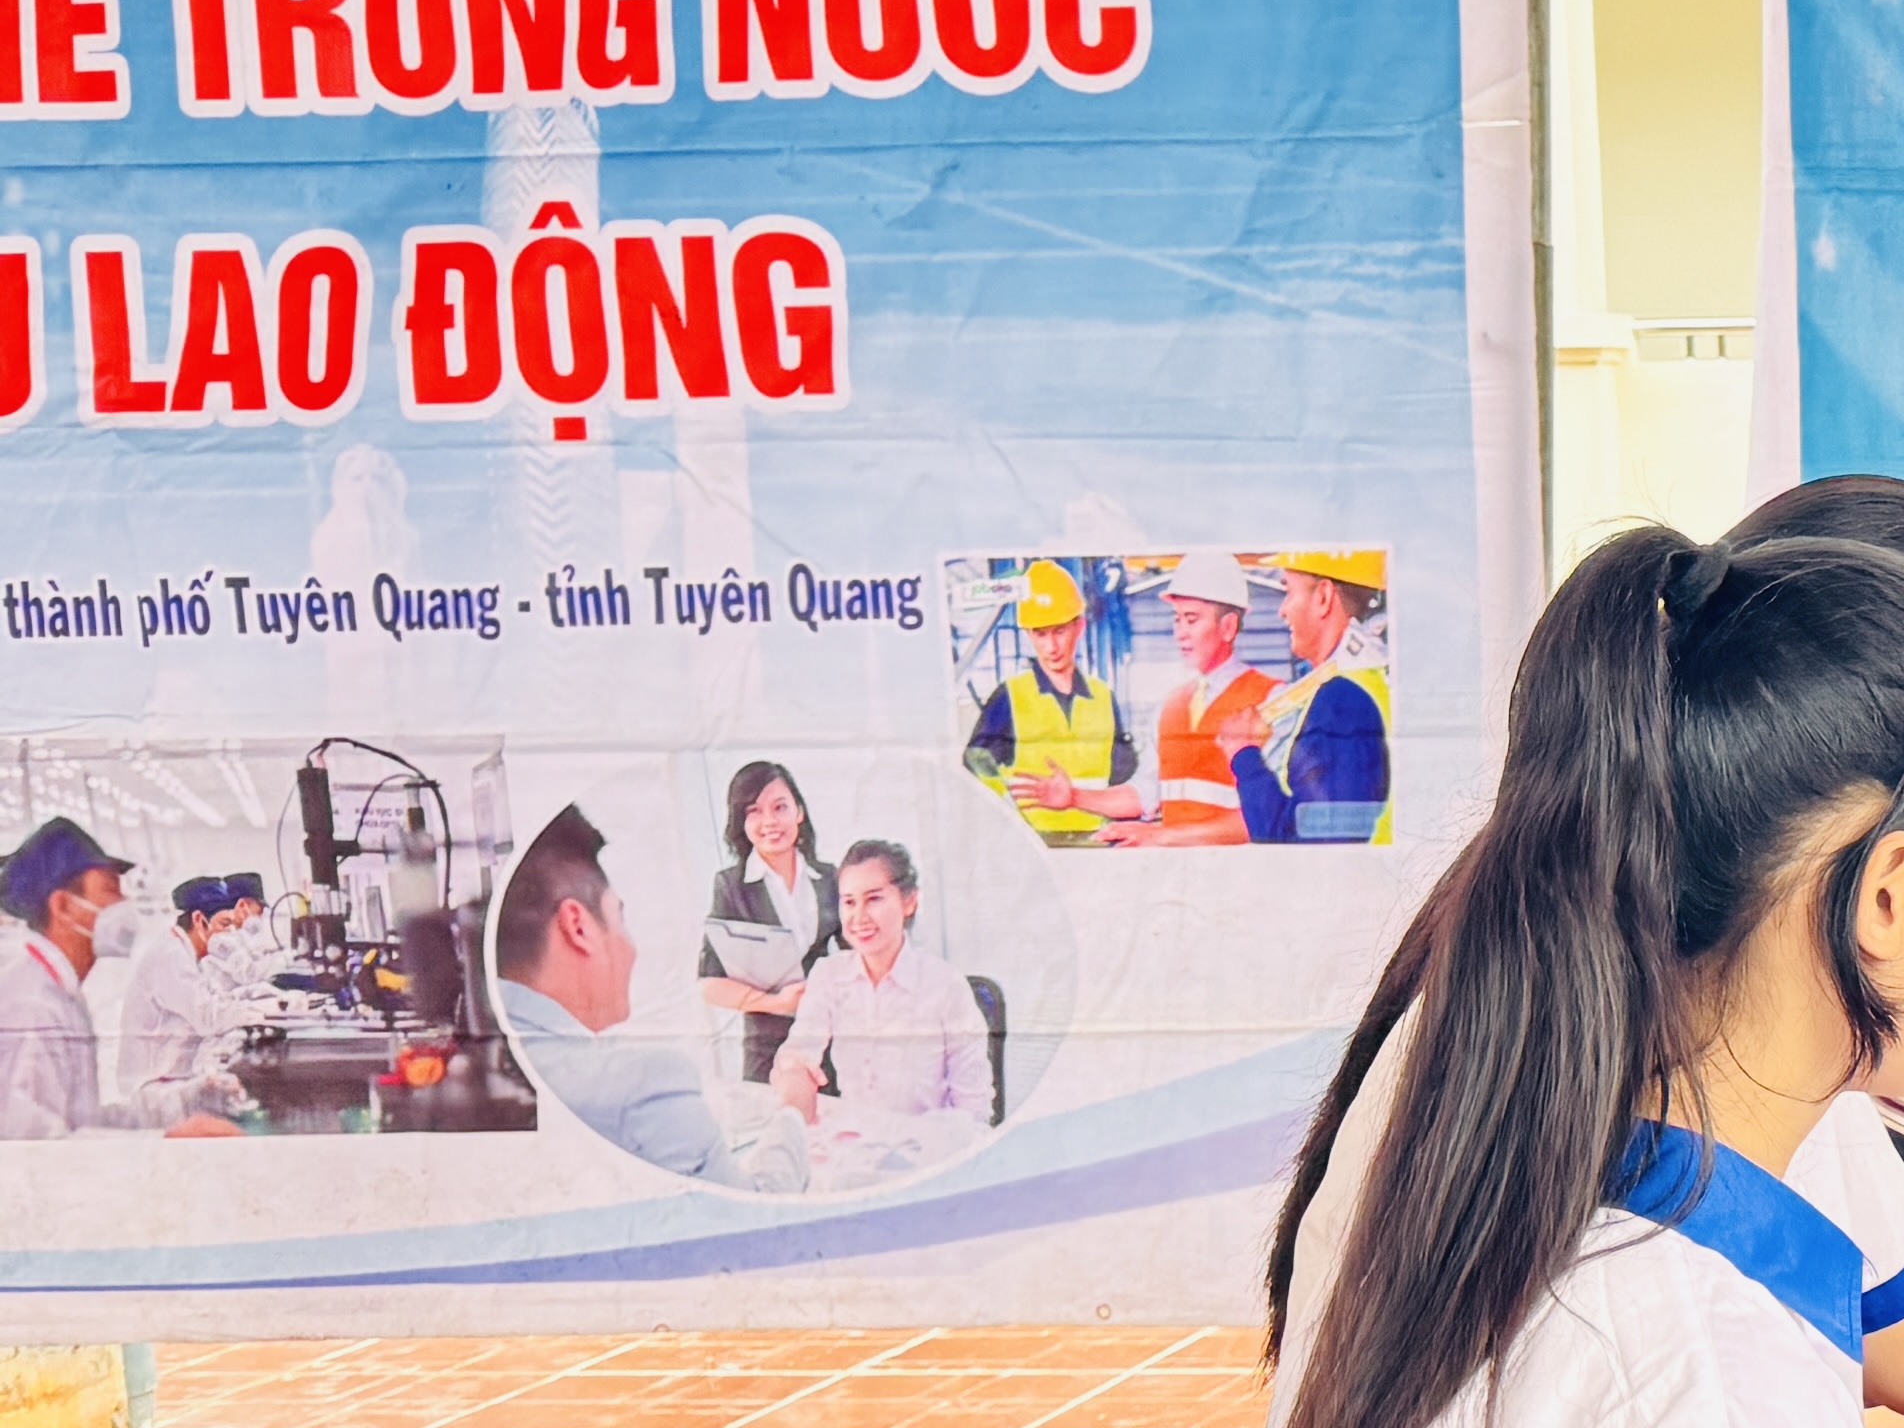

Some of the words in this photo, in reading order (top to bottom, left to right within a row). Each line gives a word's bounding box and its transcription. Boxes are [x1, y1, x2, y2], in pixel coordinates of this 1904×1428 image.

[87, 247, 357, 412] LAO
[406, 202, 833, 440] ĐỘNG
[4, 580, 122, 638] thành
[138, 571, 212, 647] phố
[226, 578, 356, 643] Tuyên
[374, 574, 500, 641] Quang
[546, 565, 629, 627] tỉnh
[645, 568, 770, 634] Tuyên
[790, 564, 923, 631] Quang
